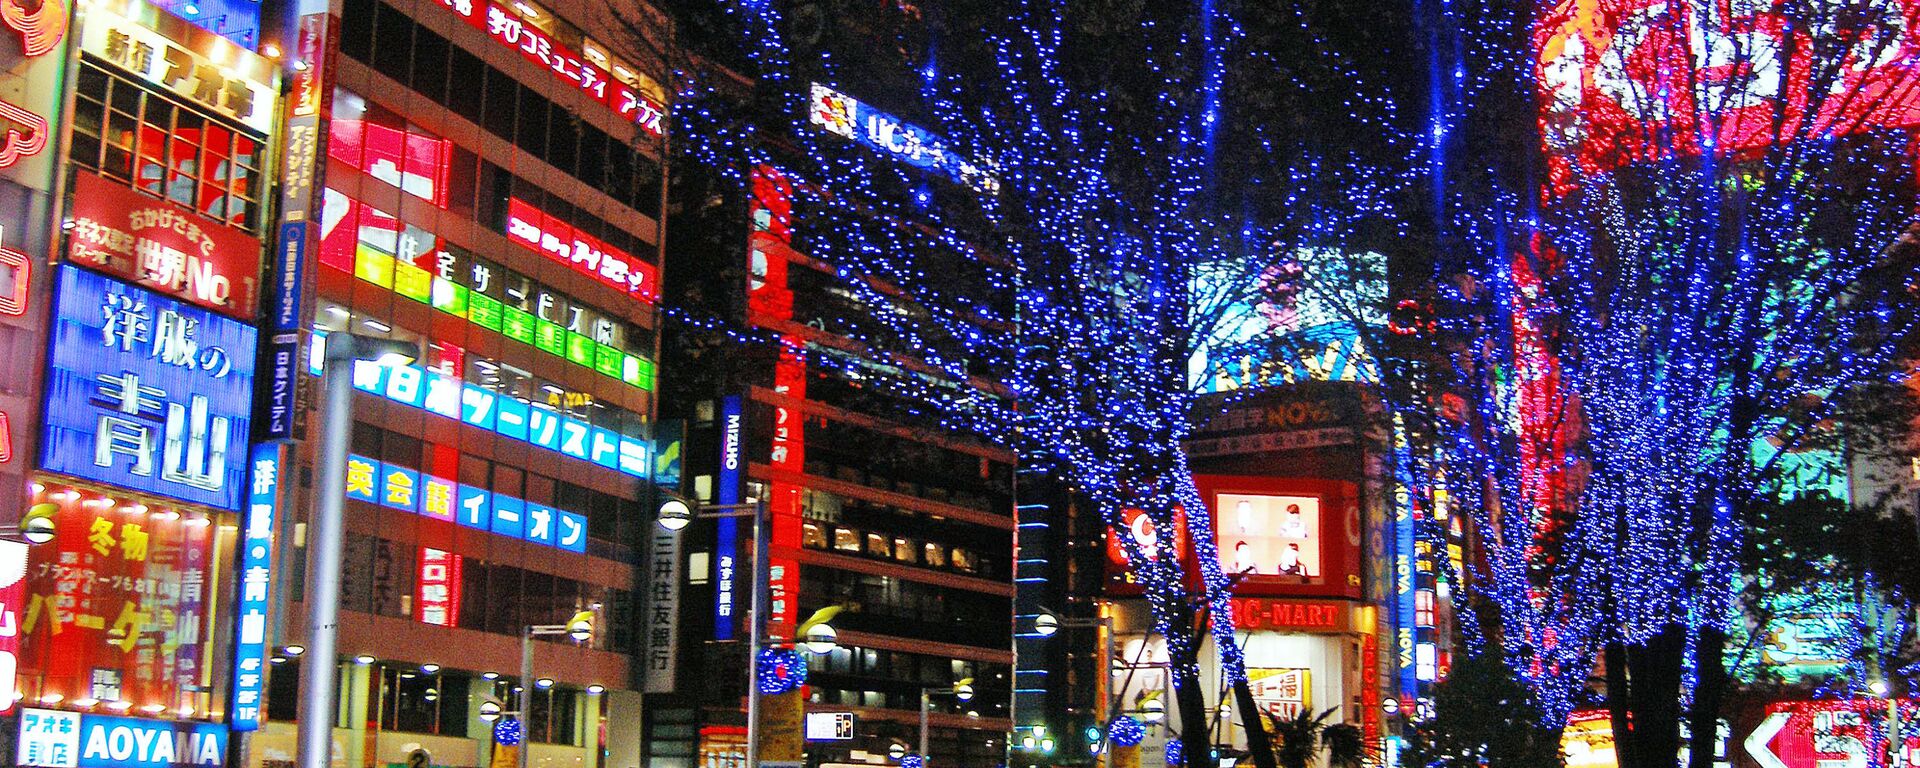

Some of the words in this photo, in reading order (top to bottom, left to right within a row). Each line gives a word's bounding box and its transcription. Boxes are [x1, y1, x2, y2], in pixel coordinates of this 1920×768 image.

[487, 6, 606, 98] 学びコミュニティ
[128, 207, 216, 256] おかげさまで
[101, 292, 232, 379] 洋服の
[91, 372, 229, 492] 青山
[726, 414, 740, 470] MIZUHO
[88, 517, 149, 561] 冬物
[244, 460, 276, 644] 洋服の青山
[1397, 555, 1411, 595] NOVA
[651, 534, 674, 672] 三井住友銀行
[1207, 599, 1338, 628] BC-MART
[1399, 627, 1412, 669] NOVA
[25, 713, 73, 734] アオキ
[238, 706, 258, 720] 1F
[83, 724, 221, 766] AOYAMA
